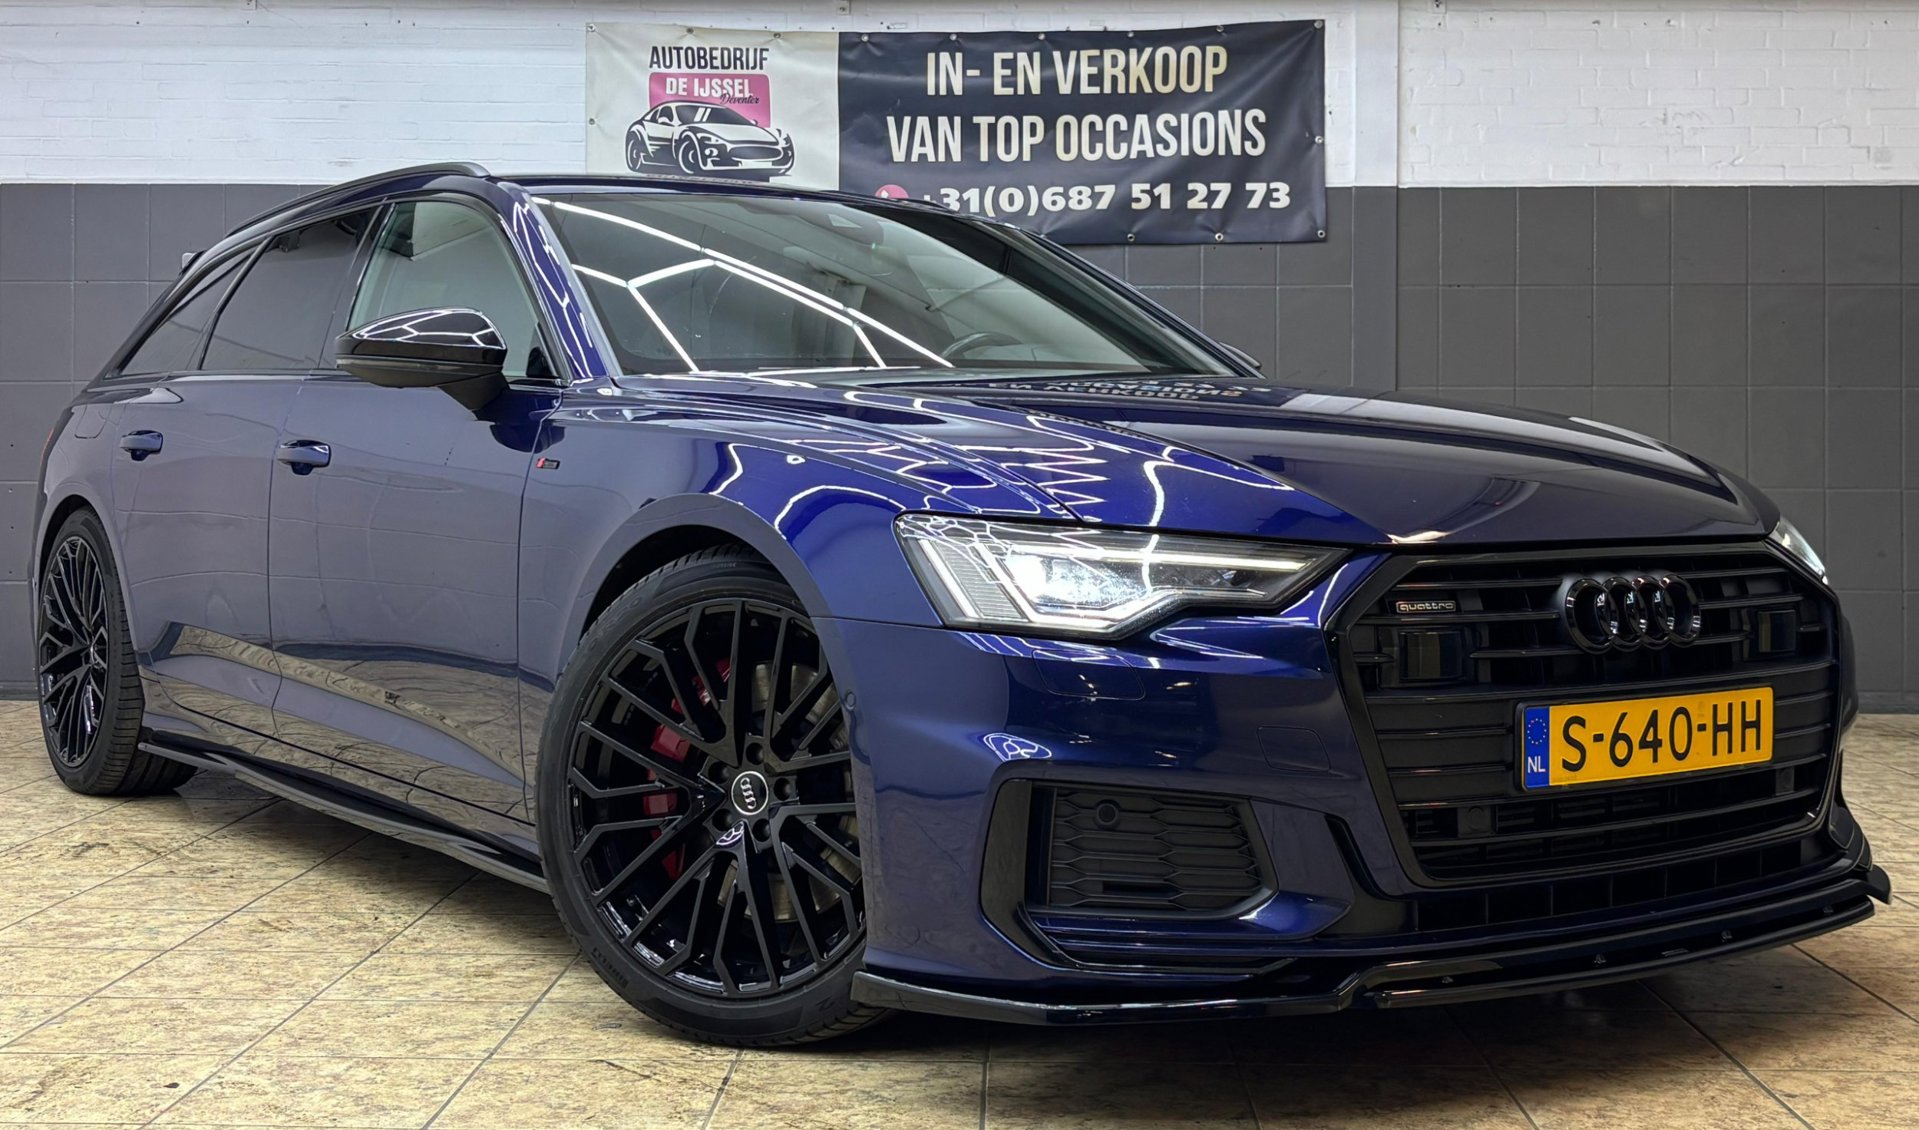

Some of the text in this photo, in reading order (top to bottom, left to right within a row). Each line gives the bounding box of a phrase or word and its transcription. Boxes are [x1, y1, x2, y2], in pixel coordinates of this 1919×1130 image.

[649, 46, 770, 71] AUTOBEDRIJF
[926, 45, 1228, 96] IN- EN VERKOOP
[665, 77, 753, 98] DE IJSSEL
[720, 93, 760, 105] Deventer
[886, 108, 1267, 163] VAN TOP OCCASIONS
[1130, 182, 1172, 210] 51
[1186, 182, 1232, 210] 27
[1244, 181, 1291, 209] 73
[1399, 602, 1454, 612] quattro
[1561, 699, 1762, 773] S-640-HH
[1527, 755, 1546, 774] NL
